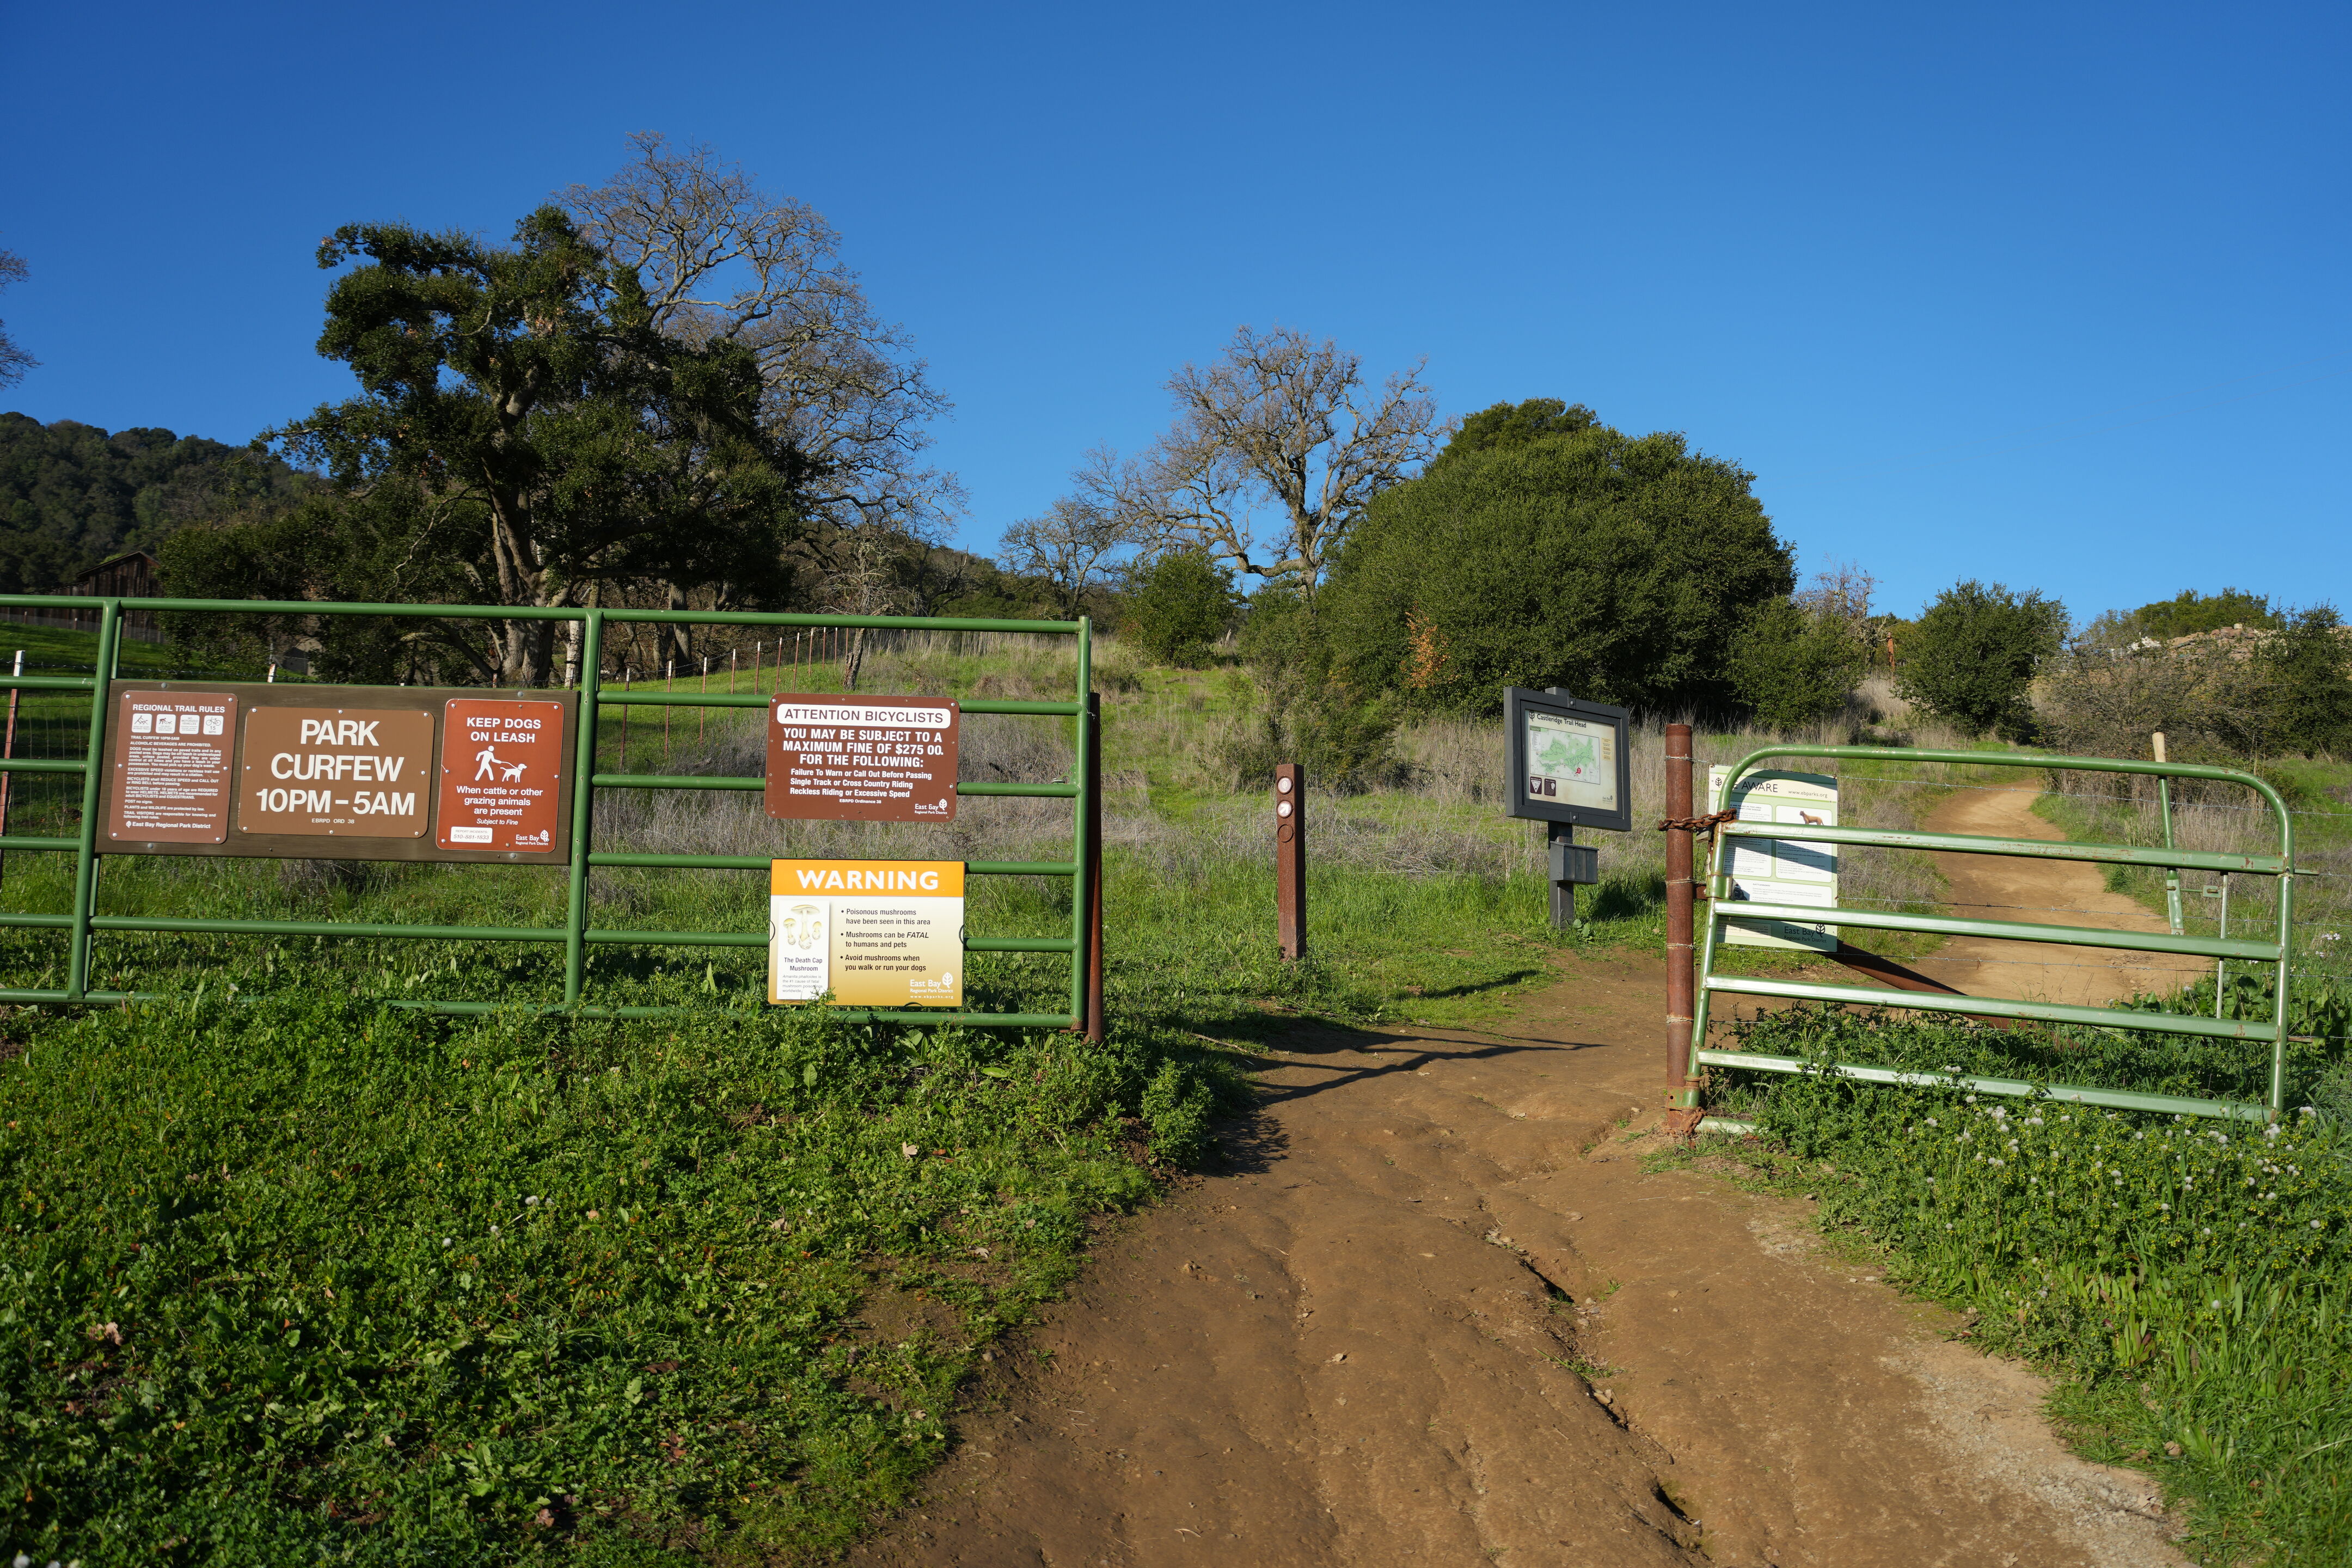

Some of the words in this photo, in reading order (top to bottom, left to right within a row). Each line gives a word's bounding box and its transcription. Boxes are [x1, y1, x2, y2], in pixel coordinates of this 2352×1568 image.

[785, 709, 860, 720] ATTENTION
[865, 711, 943, 723] BICYCLISTS
[1536, 714, 1563, 725] Castleridge
[467, 717, 500, 727] KEEP
[505, 718, 541, 729] DOGS
[301, 719, 379, 746] PARK
[470, 731, 489, 741] ON
[494, 732, 535, 743] LEASH
[783, 727, 806, 738] YOU
[811, 728, 836, 739] MAY
[840, 730, 855, 740] BE
[859, 730, 911, 742] SUBJECT
[915, 731, 930, 742] TO
[934, 732, 942, 742] A
[783, 740, 842, 752] MAXIMUM
[847, 742, 872, 753] FINE
[877, 743, 892, 754] OF
[895, 743, 923, 755] $275
[271, 752, 405, 781] CURFEW
[800, 754, 822, 764] FOR
[826, 755, 849, 765] THE
[853, 755, 923, 767] FOLLOWING:
[905, 771, 932, 780] Passing
[790, 777, 811, 786] Single
[863, 780, 890, 788] Country
[892, 781, 913, 789] Riding
[1741, 781, 1778, 793] AWARE
[456, 786, 481, 794] When
[483, 787, 507, 795] cattle
[520, 788, 543, 796] other
[822, 788, 843, 797] Riding
[889, 790, 910, 798] Speed
[1788, 791, 1828, 799] www.ebparks.org
[464, 797, 495, 806] grazing
[498, 797, 530, 806] animals
[490, 808, 523, 816] present
[796, 870, 938, 890] WARNING
[1802, 928, 1815, 938] Bay
[928, 980, 941, 989] Bay
